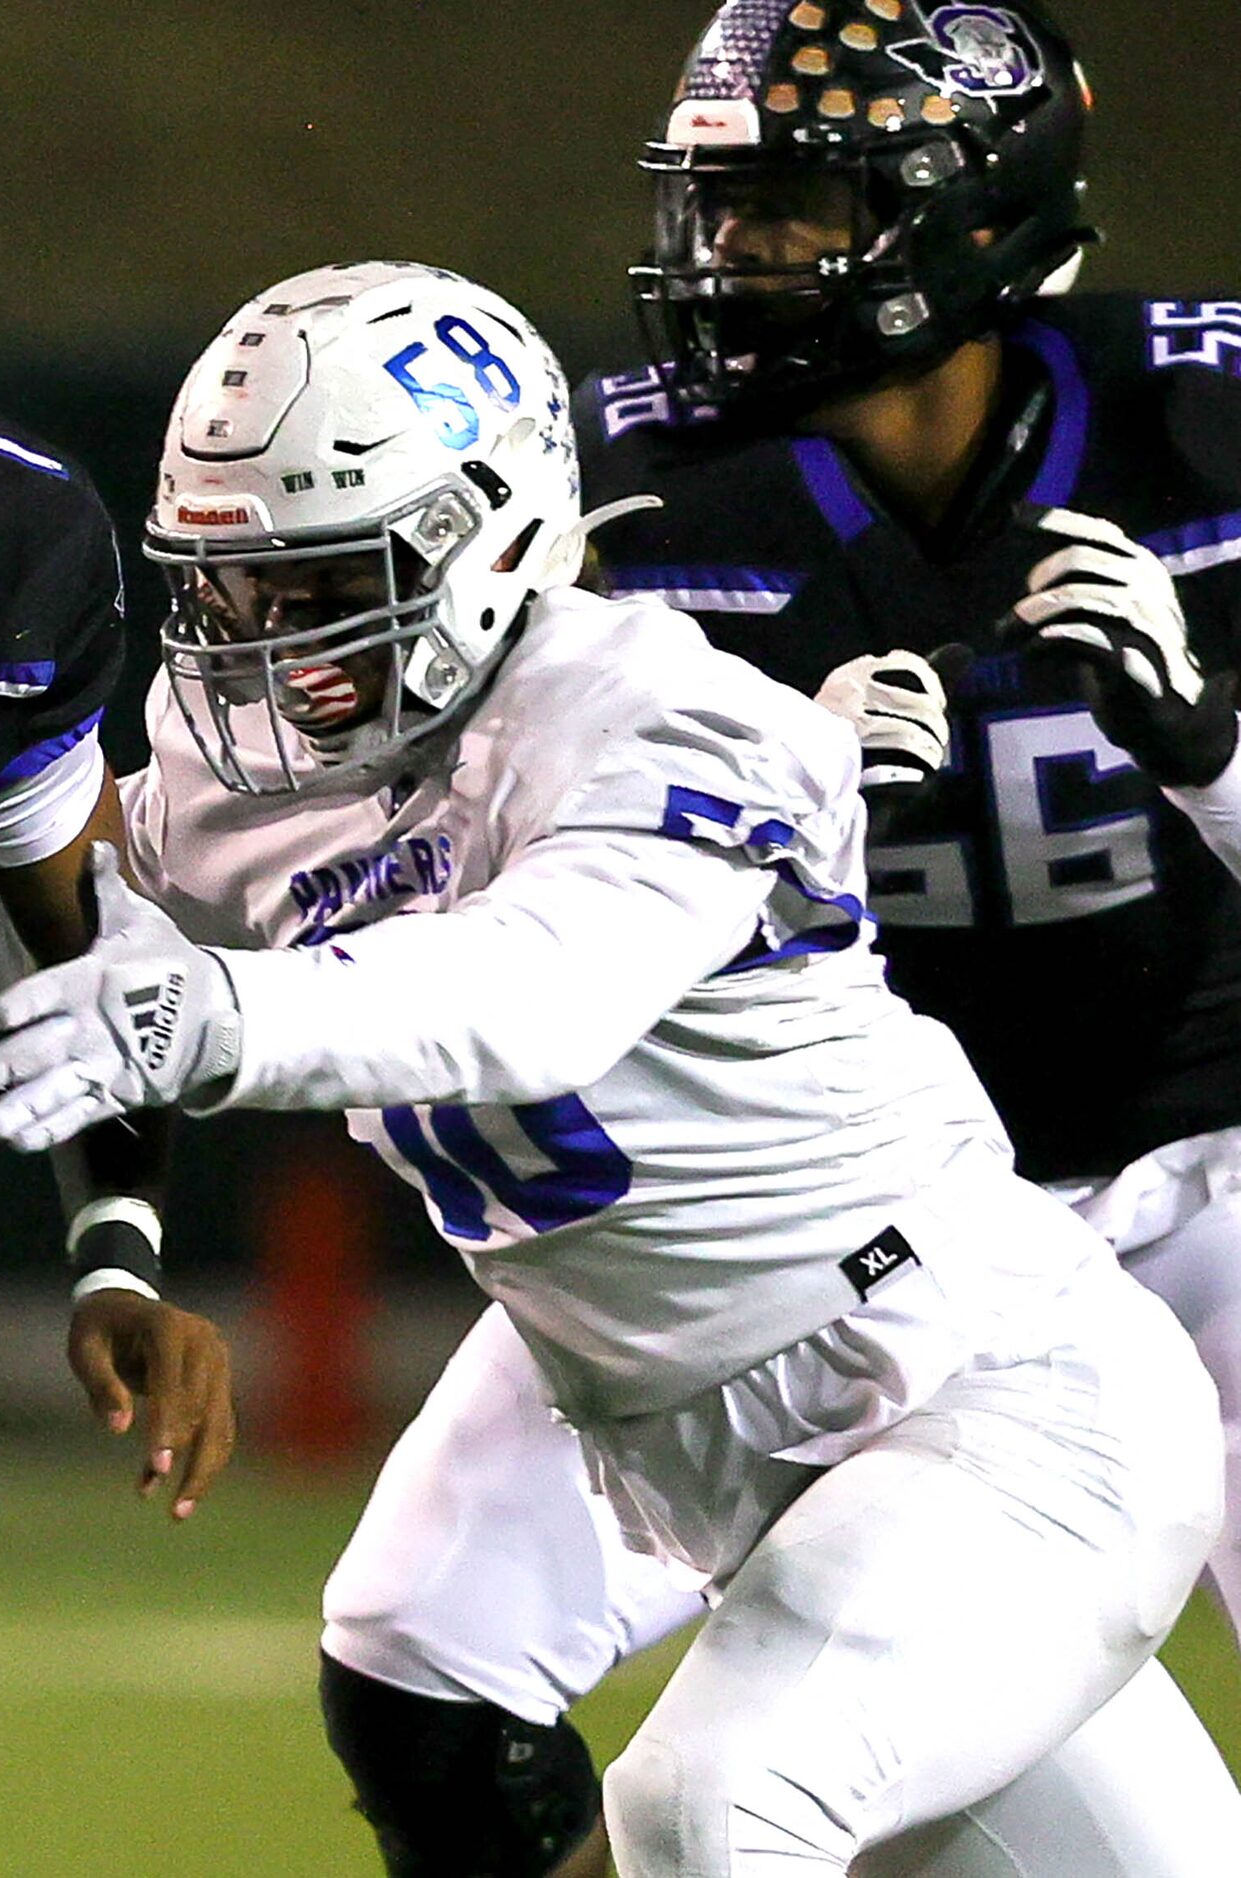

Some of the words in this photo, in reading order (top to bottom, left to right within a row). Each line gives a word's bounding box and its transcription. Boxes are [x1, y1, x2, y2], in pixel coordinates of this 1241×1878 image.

[382, 314, 521, 451] 58
[280, 470, 316, 494] WIN
[330, 468, 366, 490] WIN
[146, 972, 185, 1071] adidas
[858, 1246, 899, 1277] XL
